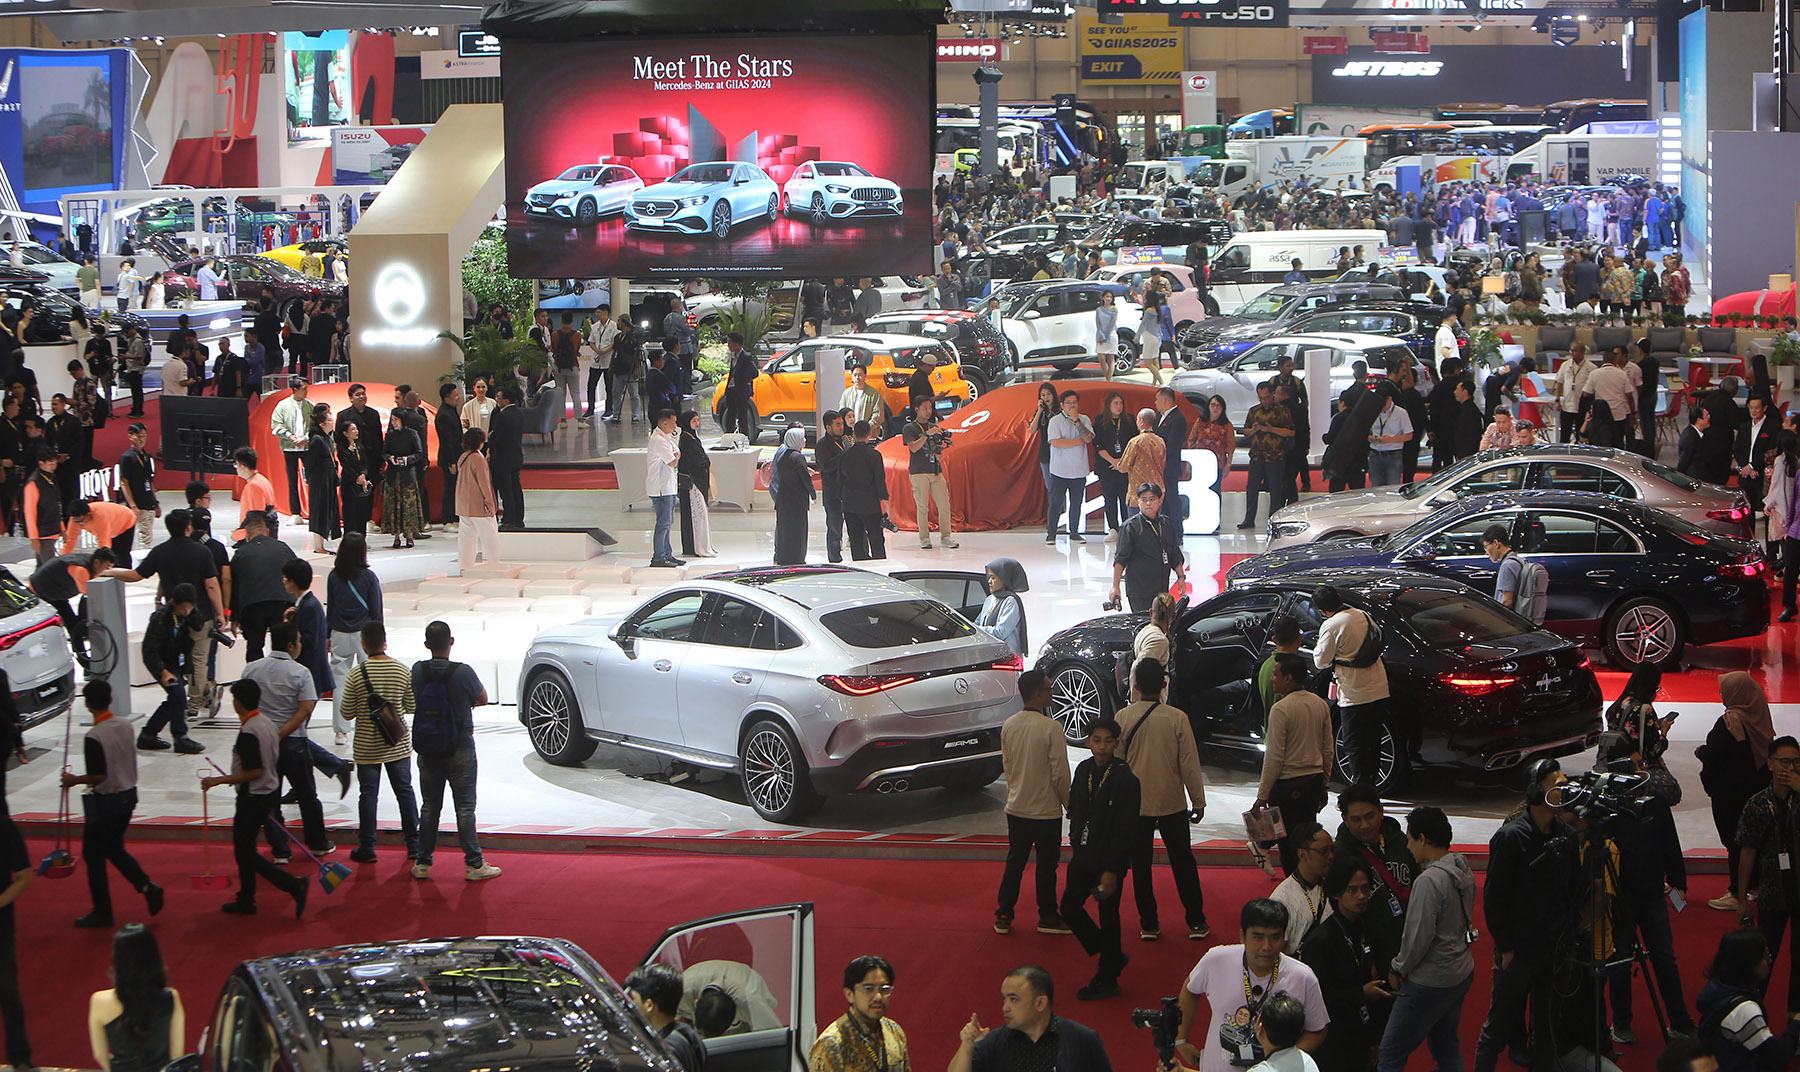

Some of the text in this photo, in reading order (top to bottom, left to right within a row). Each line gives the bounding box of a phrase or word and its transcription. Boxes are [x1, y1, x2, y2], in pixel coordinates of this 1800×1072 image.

[1104, 38, 1177, 48] GIIAS2025
[938, 45, 996, 56] HINO
[633, 53, 793, 80] Meet The Stars
[1091, 62, 1125, 72] EXIT
[1331, 61, 1444, 76] JETBUS
[654, 79, 771, 90] Mercedes-Benz at GIIAS 2024
[1269, 254, 1290, 262] assa
[952, 738, 979, 747] AMG
